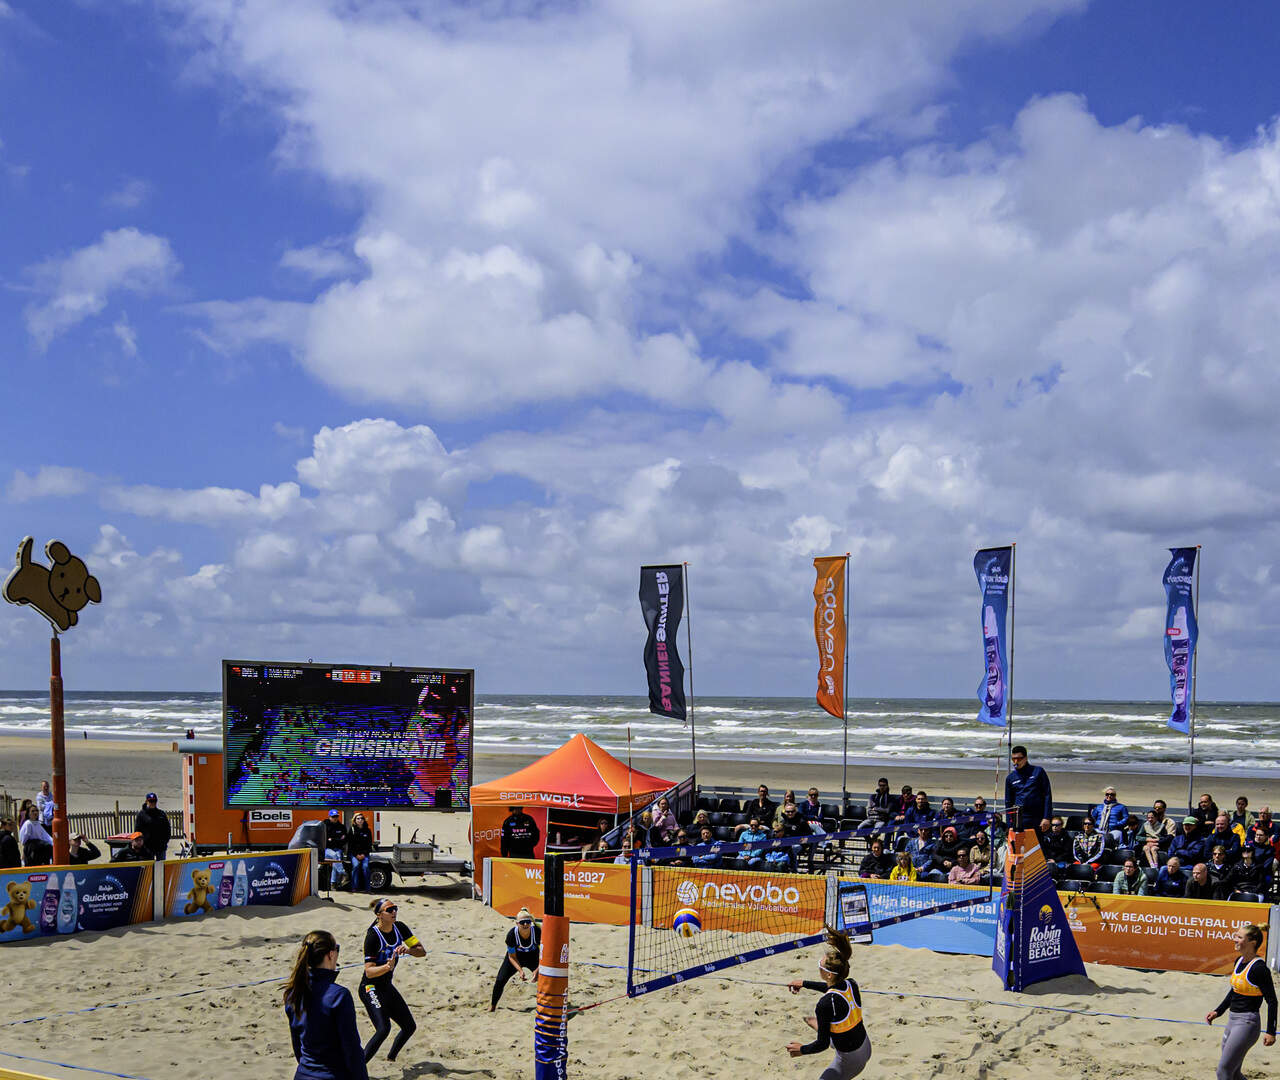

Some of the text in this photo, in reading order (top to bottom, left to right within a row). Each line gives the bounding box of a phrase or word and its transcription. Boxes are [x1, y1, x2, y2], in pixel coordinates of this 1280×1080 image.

[315, 738, 447, 758] GEURSENSATIE
[499, 791, 585, 808] SPORTWORX
[251, 811, 291, 822] Boels
[252, 877, 289, 887] Quickwash
[525, 868, 543, 880] WK
[577, 871, 606, 884] 2027
[82, 892, 129, 902] Quickwash
[702, 881, 800, 905] nevobo
[872, 894, 898, 909] Mijn
[1100, 911, 1120, 921] WK
[1122, 912, 1228, 929] BEACHVOLLEYBAL
[1030, 924, 1062, 942] Robijn
[1100, 923, 1106, 932] 7
[1108, 923, 1128, 933] T/M
[1144, 926, 1167, 936] JULI
[1179, 928, 1203, 938] DEN
[1029, 937, 1061, 949] EREDIVISIE
[1029, 945, 1061, 960] BEACH
